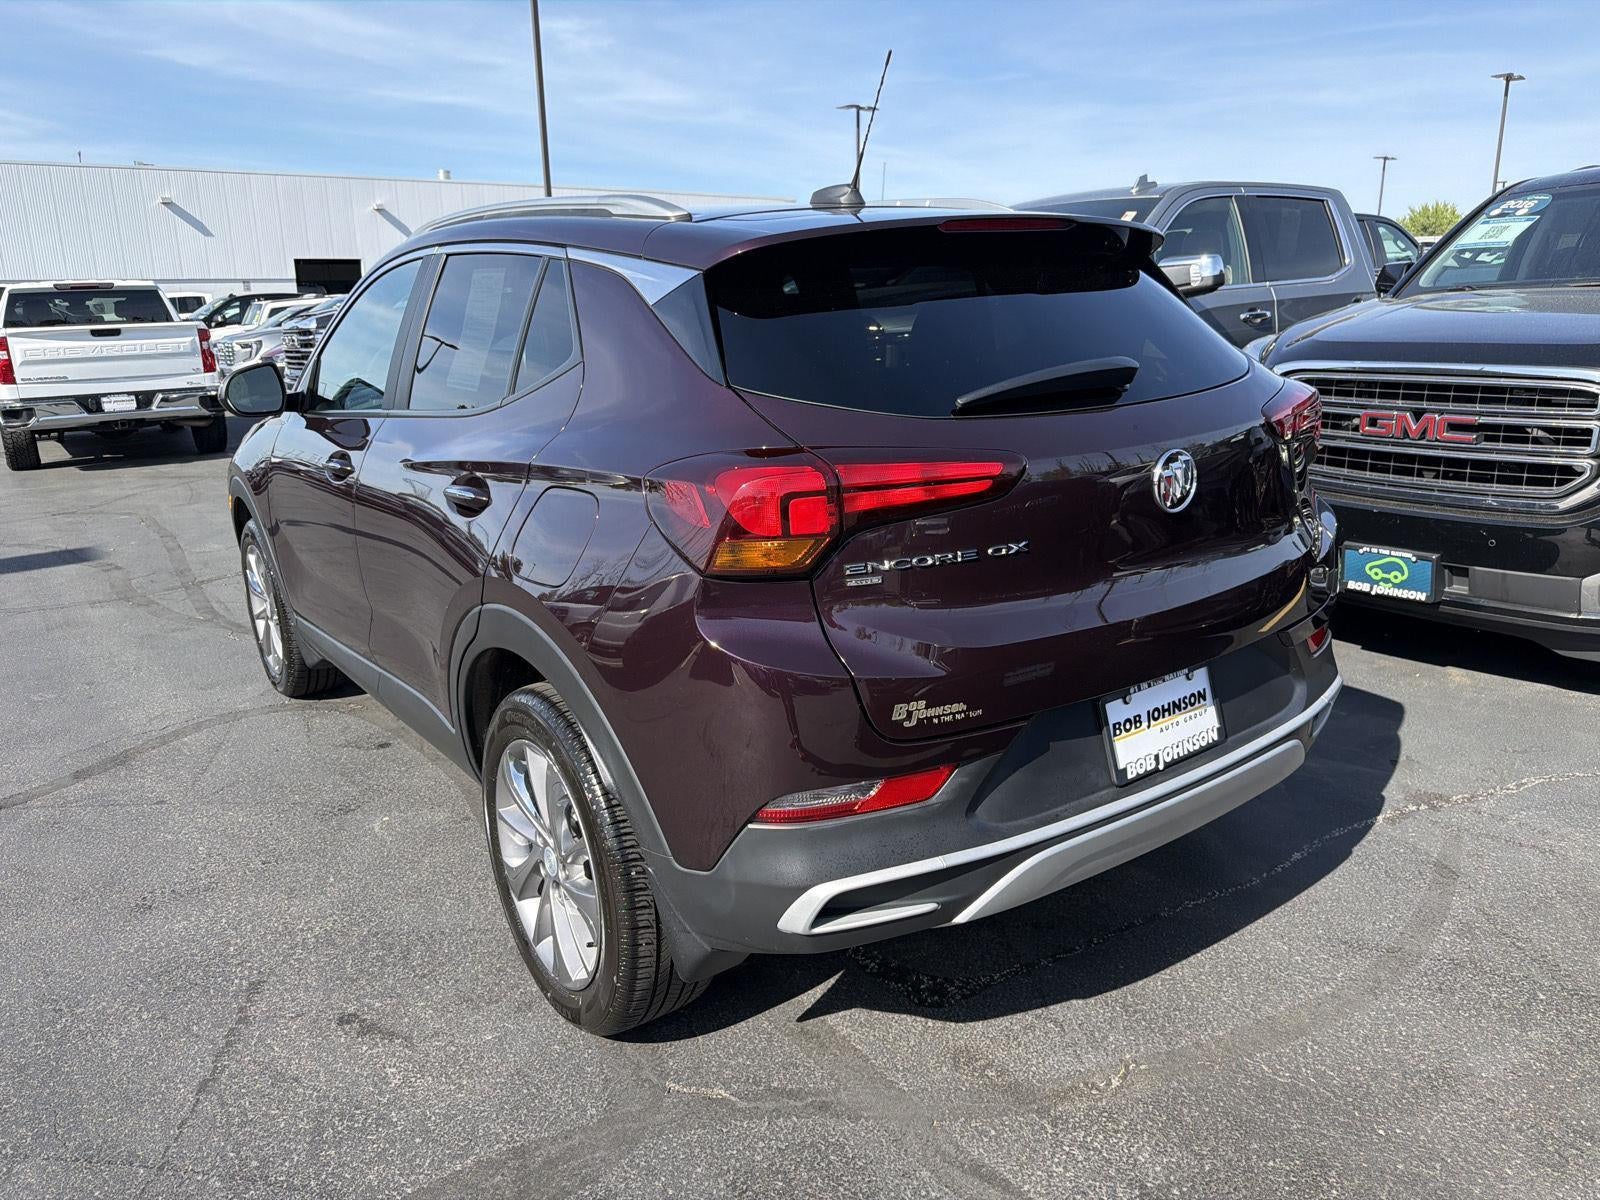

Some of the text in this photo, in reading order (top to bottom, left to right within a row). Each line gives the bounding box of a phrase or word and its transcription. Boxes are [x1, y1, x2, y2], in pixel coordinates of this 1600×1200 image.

[24, 342, 188, 360] CHEVROLET
[1360, 410, 1482, 445] GMC
[843, 540, 1030, 576] ENCORE GX
[1347, 580, 1427, 601] BOB JOHNSON
[891, 700, 967, 727] BOB JOHNSON
[955, 708, 982, 720] NAION
[1112, 688, 1207, 738] BOB JOHNSON
[1159, 708, 1208, 734] AUTO GROUP
[1126, 726, 1219, 780] BOB JOHNSON
